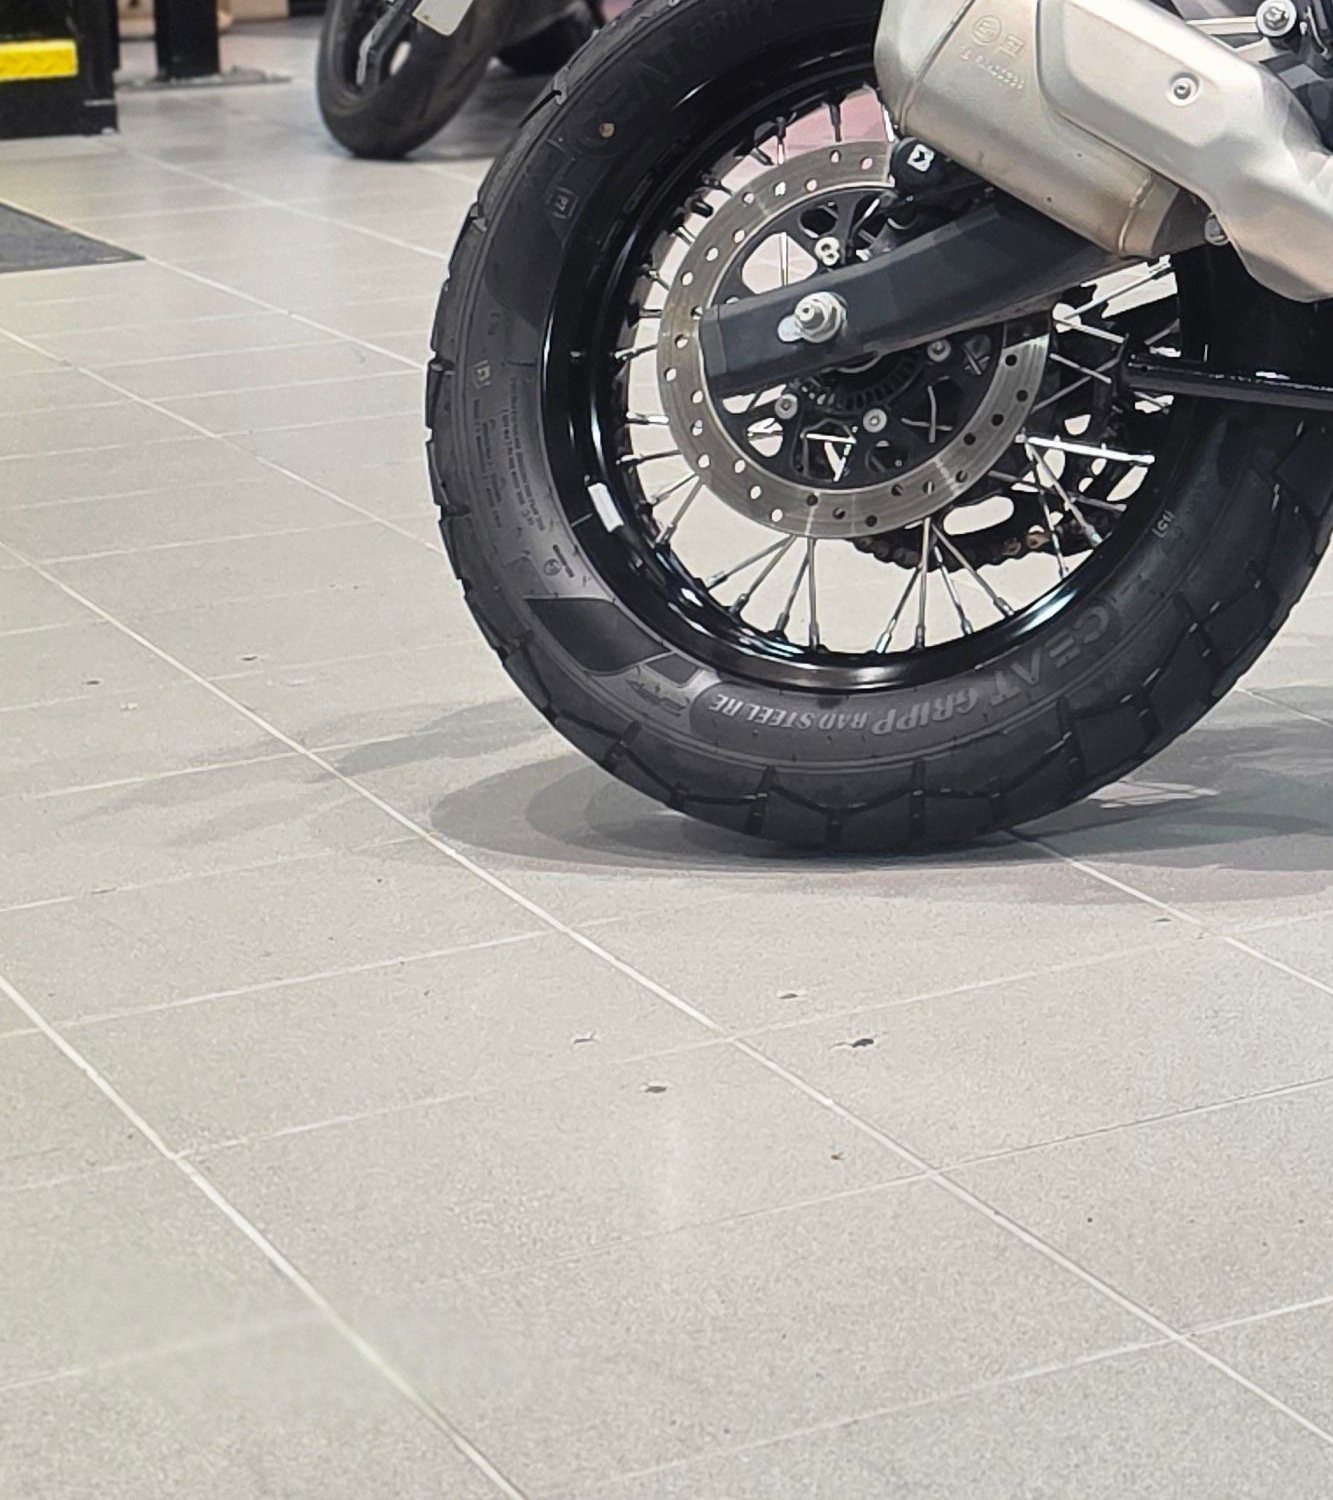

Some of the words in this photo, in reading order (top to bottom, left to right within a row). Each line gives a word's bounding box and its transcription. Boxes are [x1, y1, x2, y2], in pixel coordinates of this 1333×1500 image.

[989, 605, 1110, 706] CEAT
[708, 694, 743, 717] RE
[747, 703, 816, 729] STEEL
[872, 687, 979, 735] GRIPP
[819, 711, 869, 730] RAD
